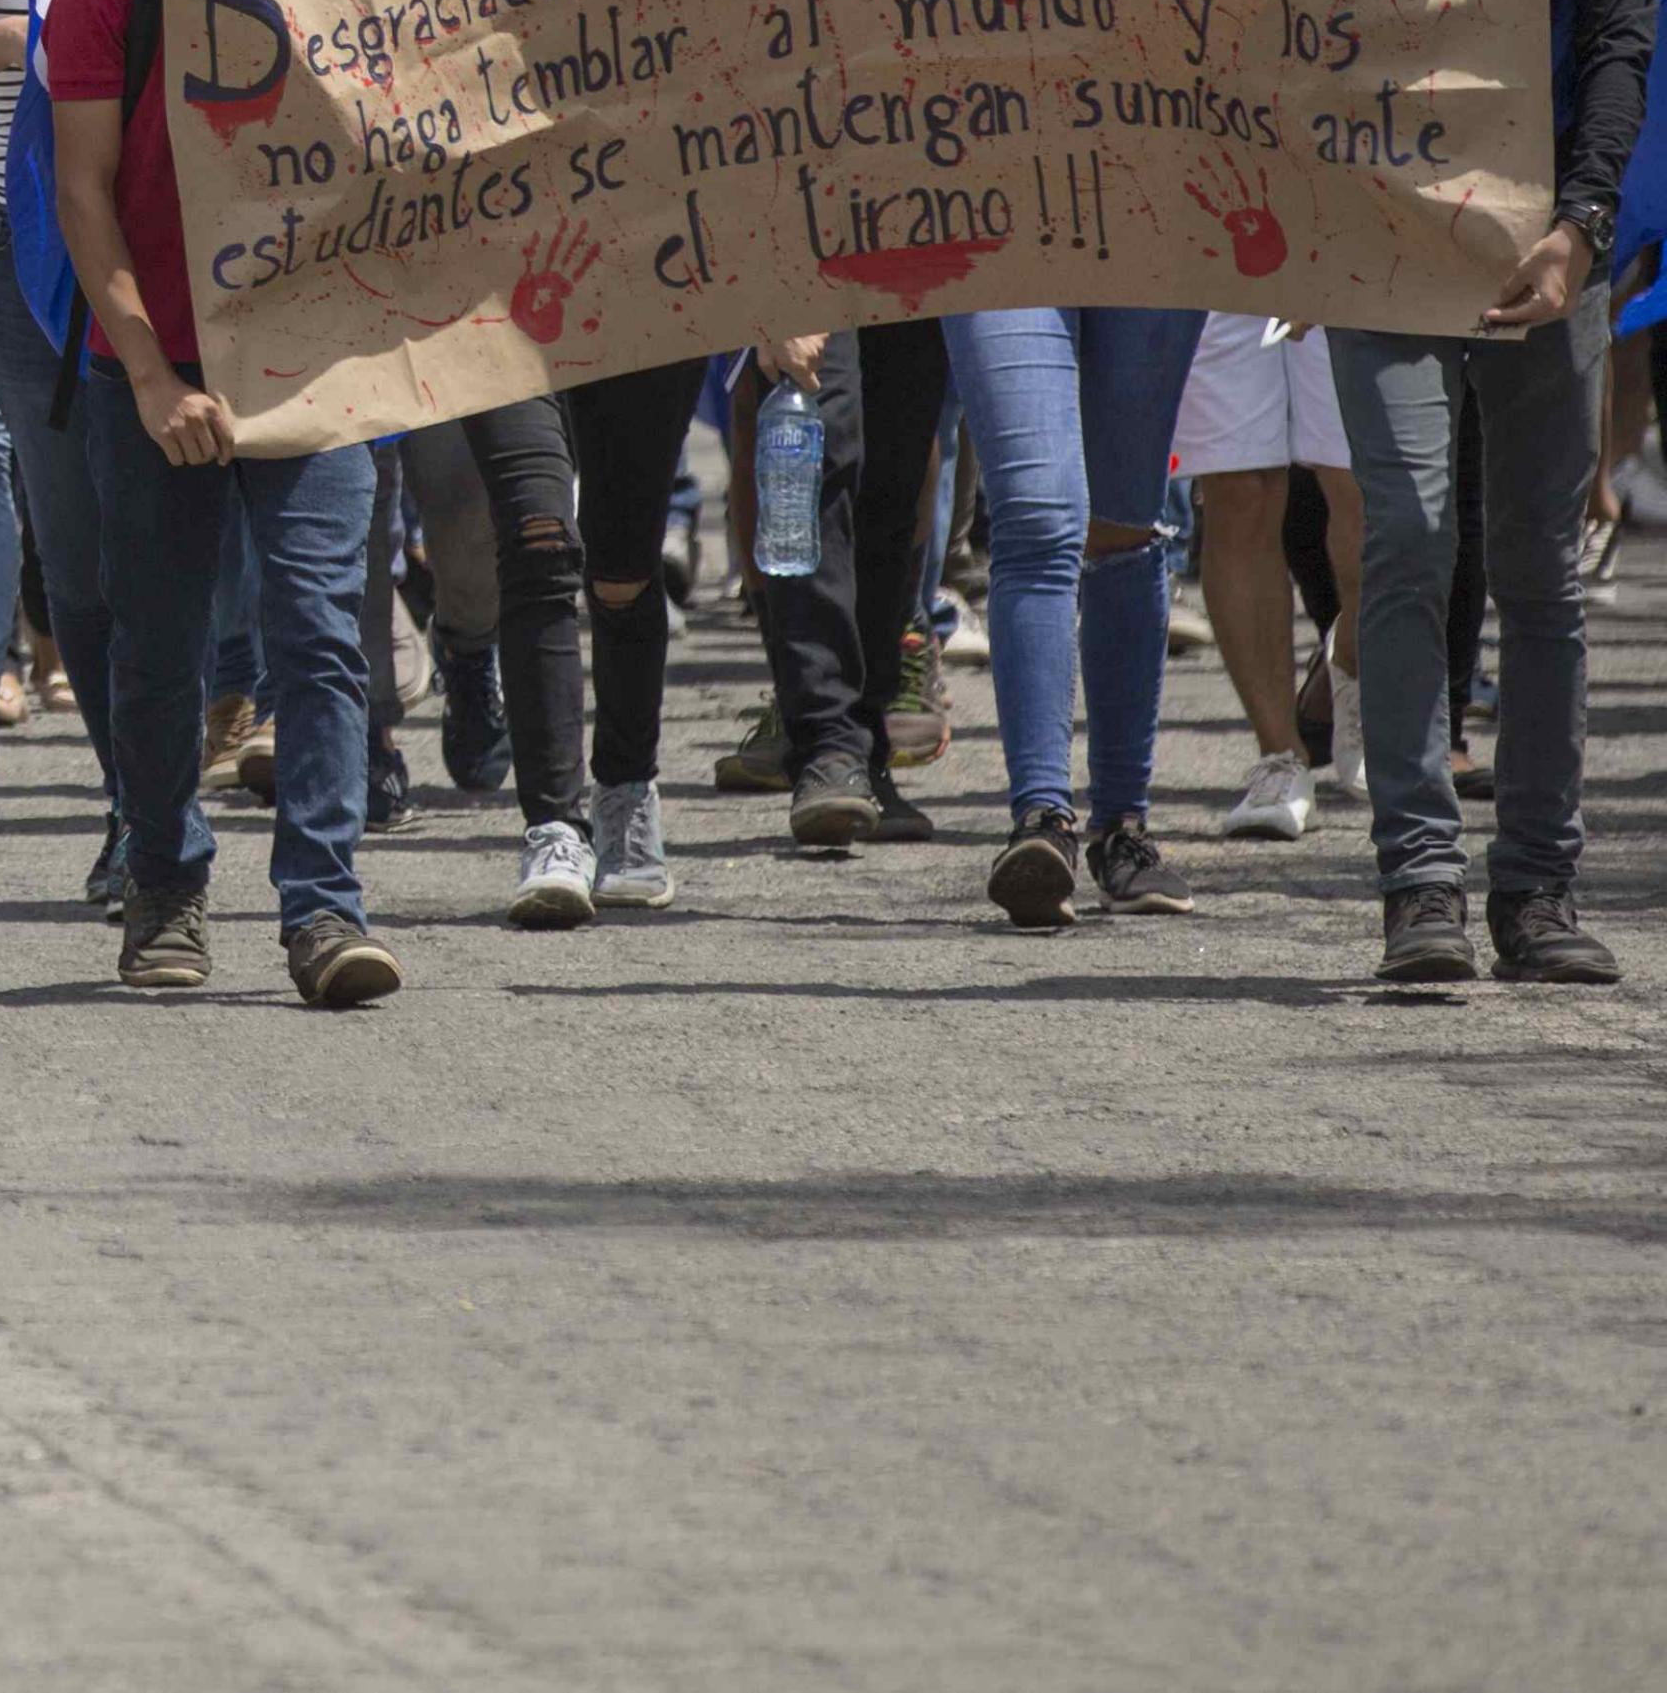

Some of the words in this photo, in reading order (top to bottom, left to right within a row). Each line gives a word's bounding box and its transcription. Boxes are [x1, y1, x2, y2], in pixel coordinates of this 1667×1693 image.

[212, 152, 533, 290] estudiantes
[571, 136, 626, 203] se
[673, 66, 1029, 176] mantengan
[1073, 76, 1279, 148] sumisos
[1312, 79, 1450, 167] ante
[258, 140, 335, 186] no
[356, 99, 460, 174] haga
[478, 5, 687, 126] temblar
[654, 189, 713, 289] el
